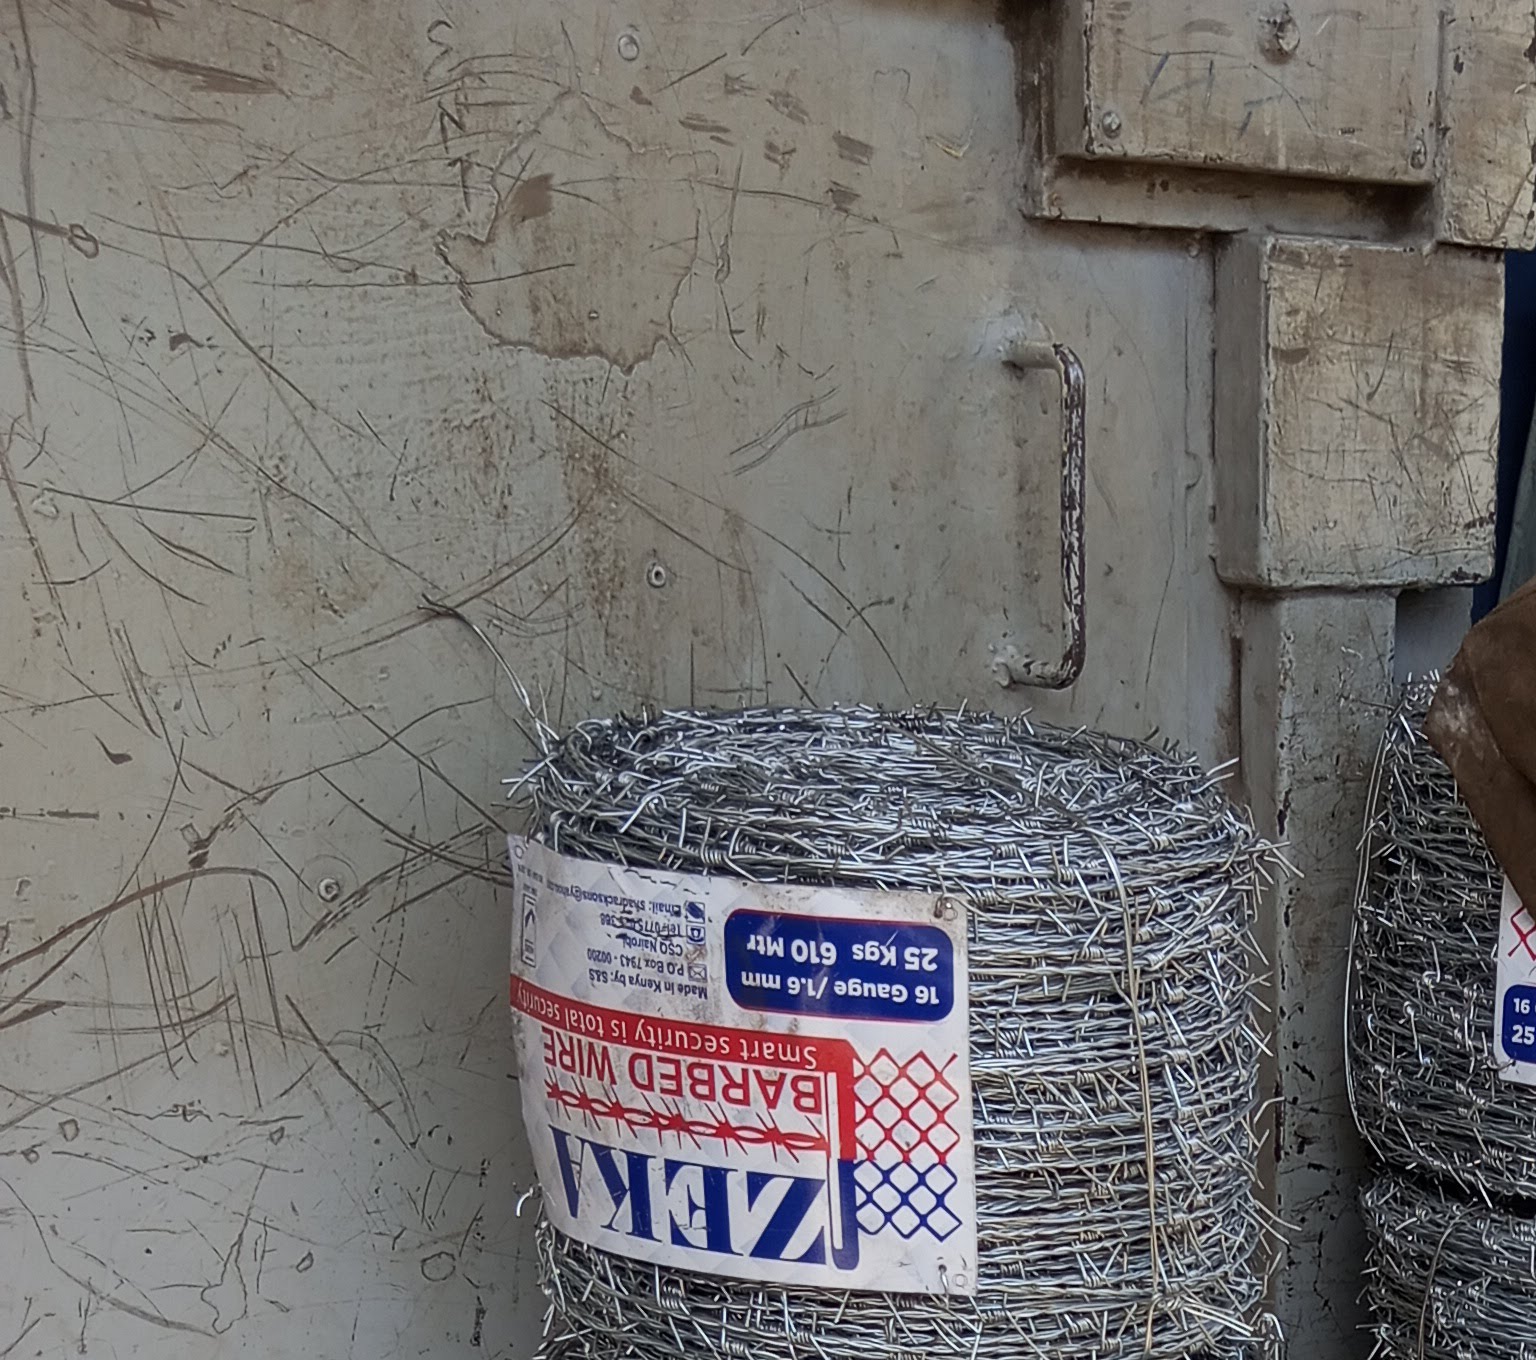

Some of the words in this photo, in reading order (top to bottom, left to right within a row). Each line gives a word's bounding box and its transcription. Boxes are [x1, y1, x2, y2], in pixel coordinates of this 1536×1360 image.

[747, 935, 785, 958] Mtr
[795, 938, 838, 965] 610
[852, 942, 896, 970] Kgs
[903, 946, 939, 971] 25
[741, 970, 782, 993] mm
[788, 975, 826, 999] /1.6
[833, 980, 907, 1006] Gauge
[517, 986, 560, 1019] security
[919, 986, 940, 1006] 16
[1513, 998, 1530, 1016] 16
[564, 1006, 605, 1034] total
[610, 1018, 629, 1043] is
[634, 1022, 730, 1056] security
[1511, 1024, 1534, 1045] 25
[543, 1025, 616, 1087] WIRE
[740, 1038, 818, 1068] Smart
[629, 1055, 823, 1114] BARBED
[548, 1124, 828, 1265] ZEKA
